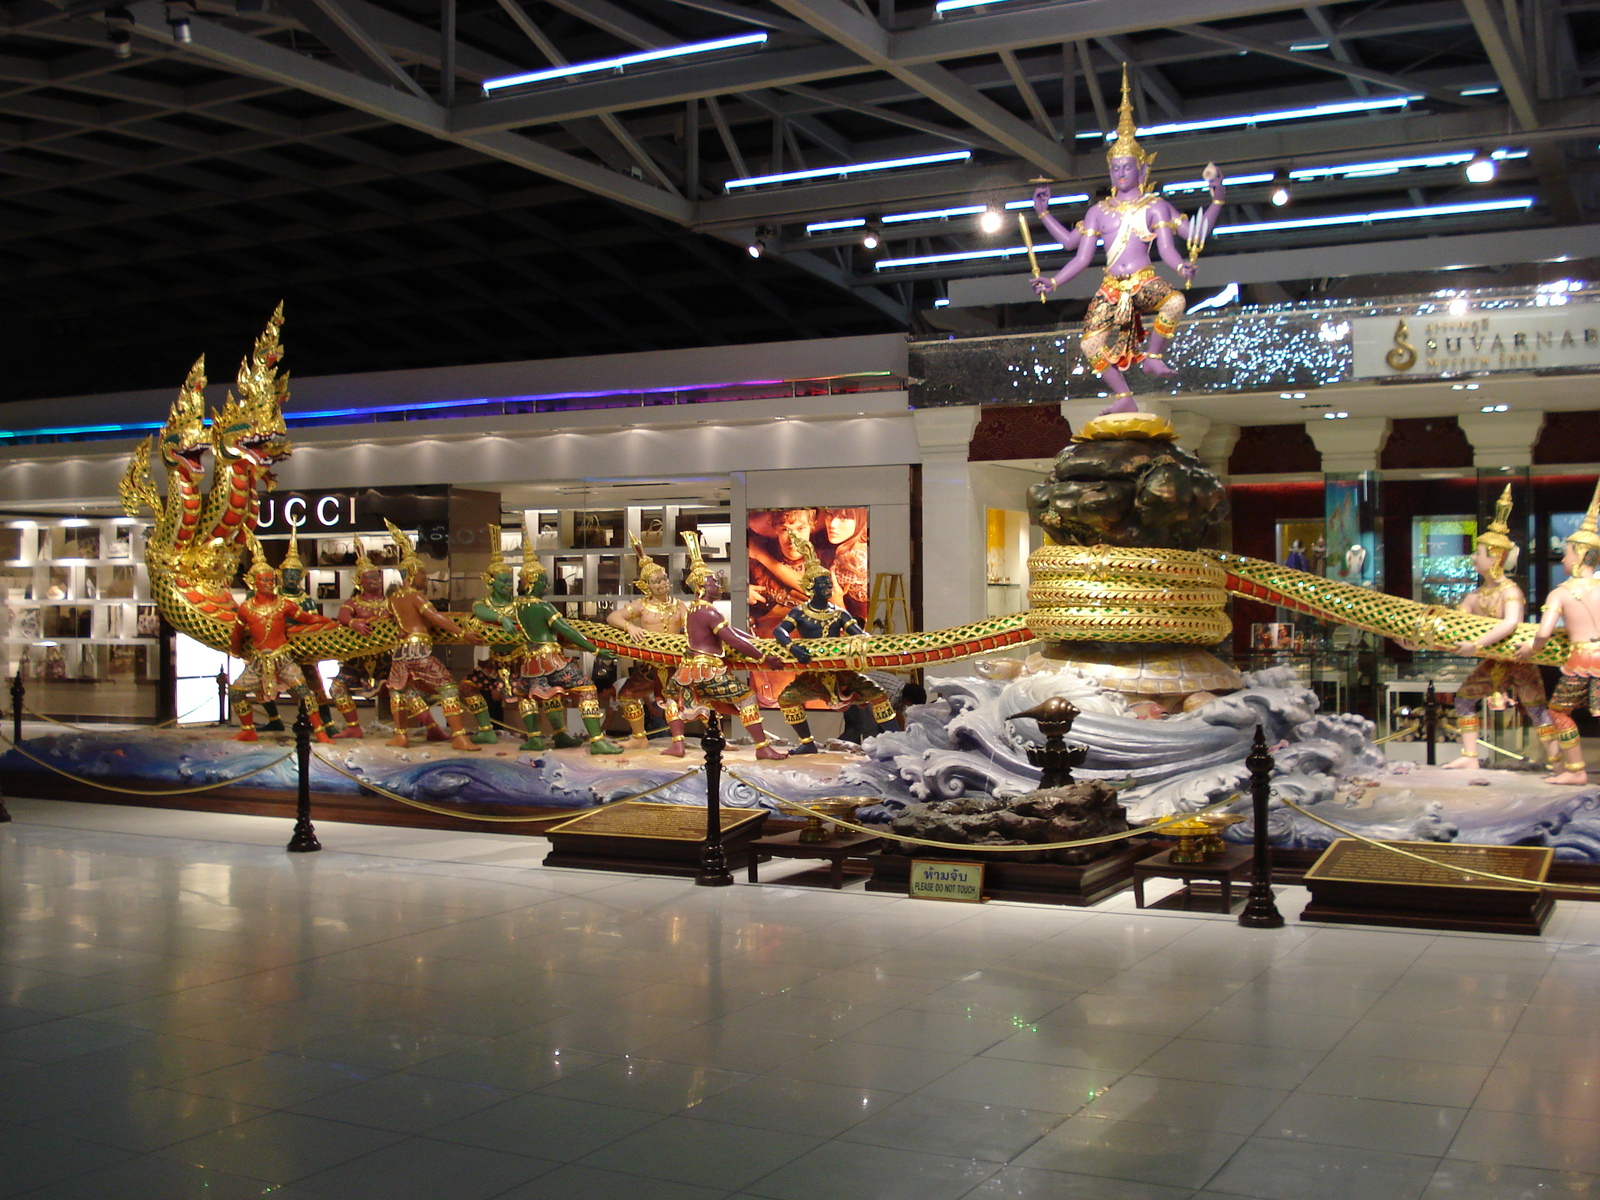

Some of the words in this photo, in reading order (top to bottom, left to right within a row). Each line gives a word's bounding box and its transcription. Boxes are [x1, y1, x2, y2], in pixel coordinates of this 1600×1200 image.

[257, 496, 355, 527] UCCI
[924, 866, 967, 881] ห้ามจับ
[915, 882, 934, 891] PLEASE
[935, 884, 943, 892] DO
[945, 884, 955, 893] NOT
[957, 885, 975, 894] TOUCH
